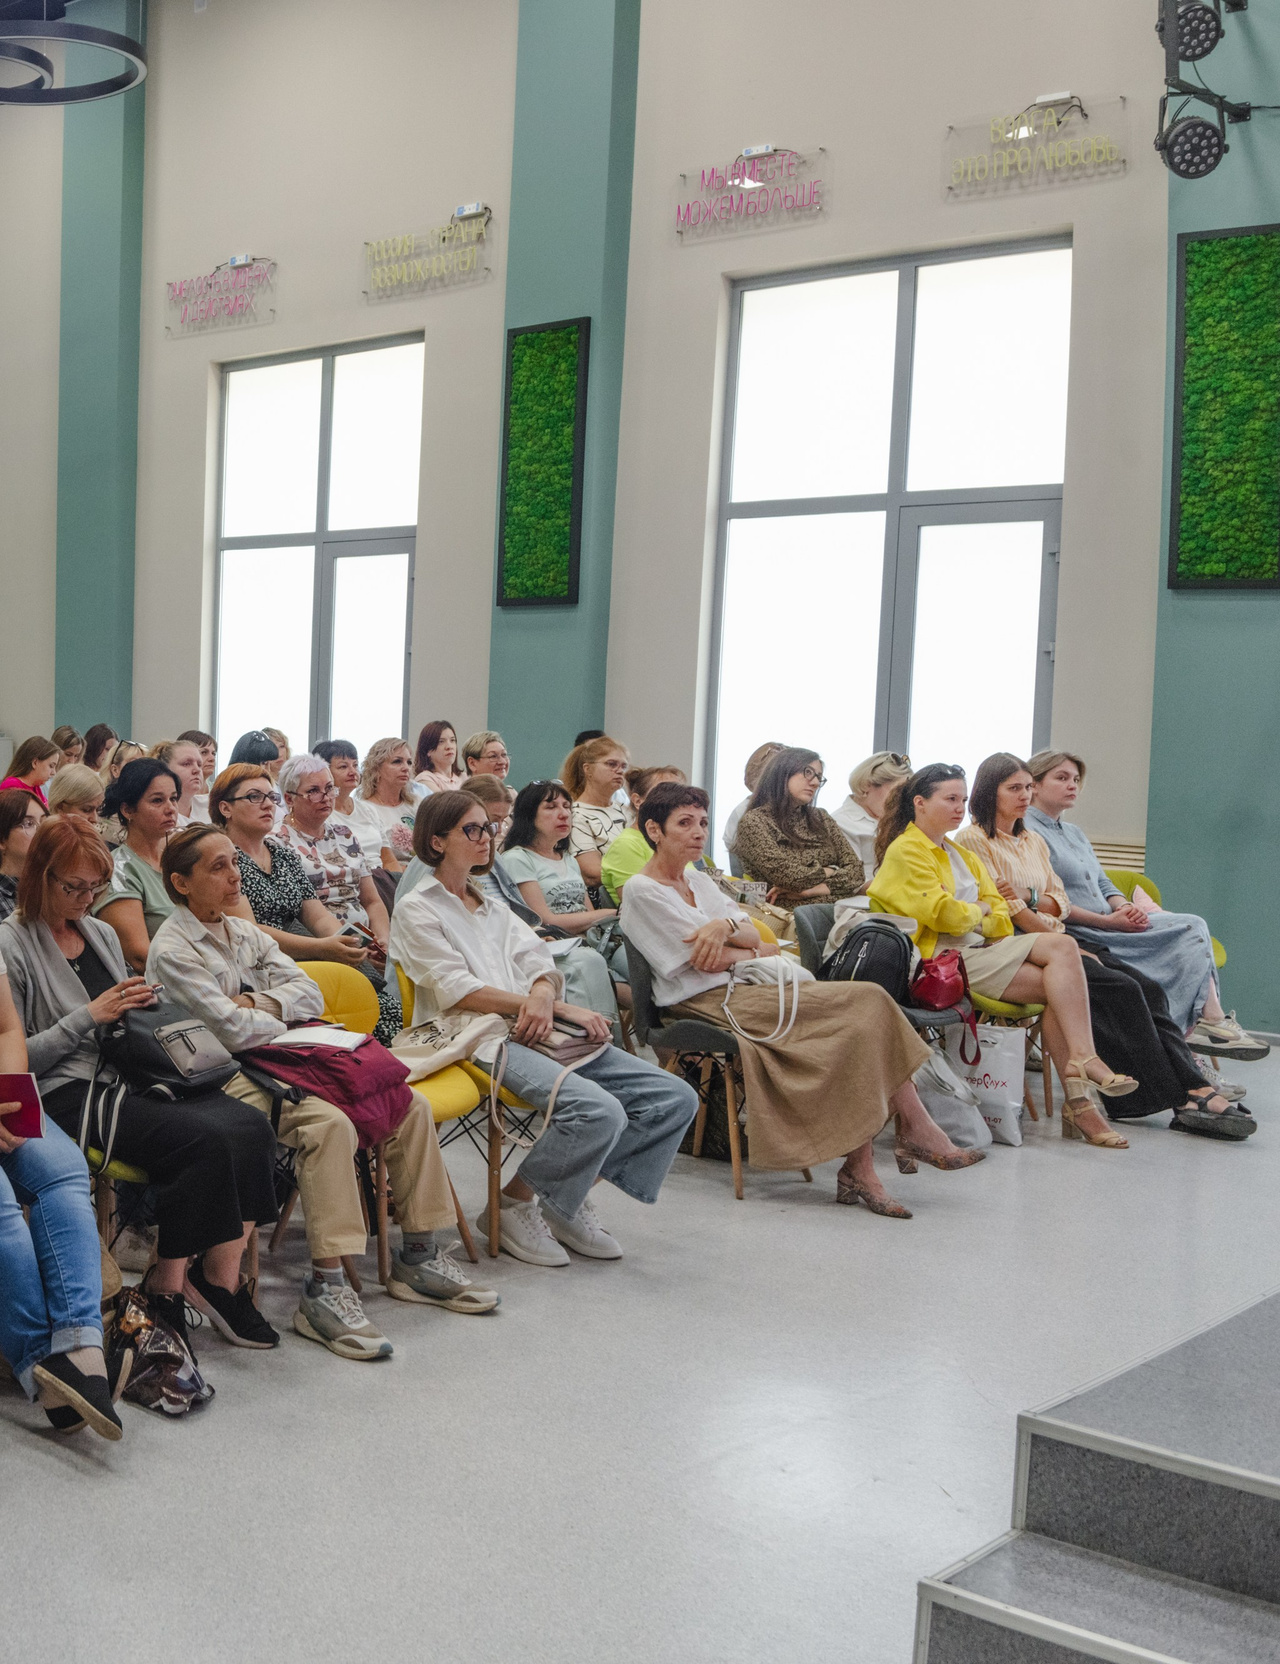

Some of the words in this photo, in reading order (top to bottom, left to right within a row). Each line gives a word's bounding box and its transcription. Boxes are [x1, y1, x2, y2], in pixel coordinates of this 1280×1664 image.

[990, 108, 1059, 143] ВОЛГА
[700, 165, 728, 192] МЫ
[730, 152, 798, 187] ВМЕСТЕ
[951, 154, 988, 184] ЭТО
[993, 147, 1031, 179] ПРО
[1033, 135, 1119, 173] ЛЮБОВЬ
[676, 192, 744, 227] МОЖЕМ
[746, 180, 822, 216] БОЛЬШЕ
[367, 233, 415, 264] РОССИЯ
[429, 218, 487, 249] СТРАНА
[167, 272, 222, 301] СМЕЛОСТЬ
[232, 262, 272, 289] ИДЕАХ
[370, 245, 477, 289] ВОЗМОЖНОСТЕЙ
[180, 304, 189, 324] И
[191, 291, 256, 322] ДЕЙСТВИЯХ
